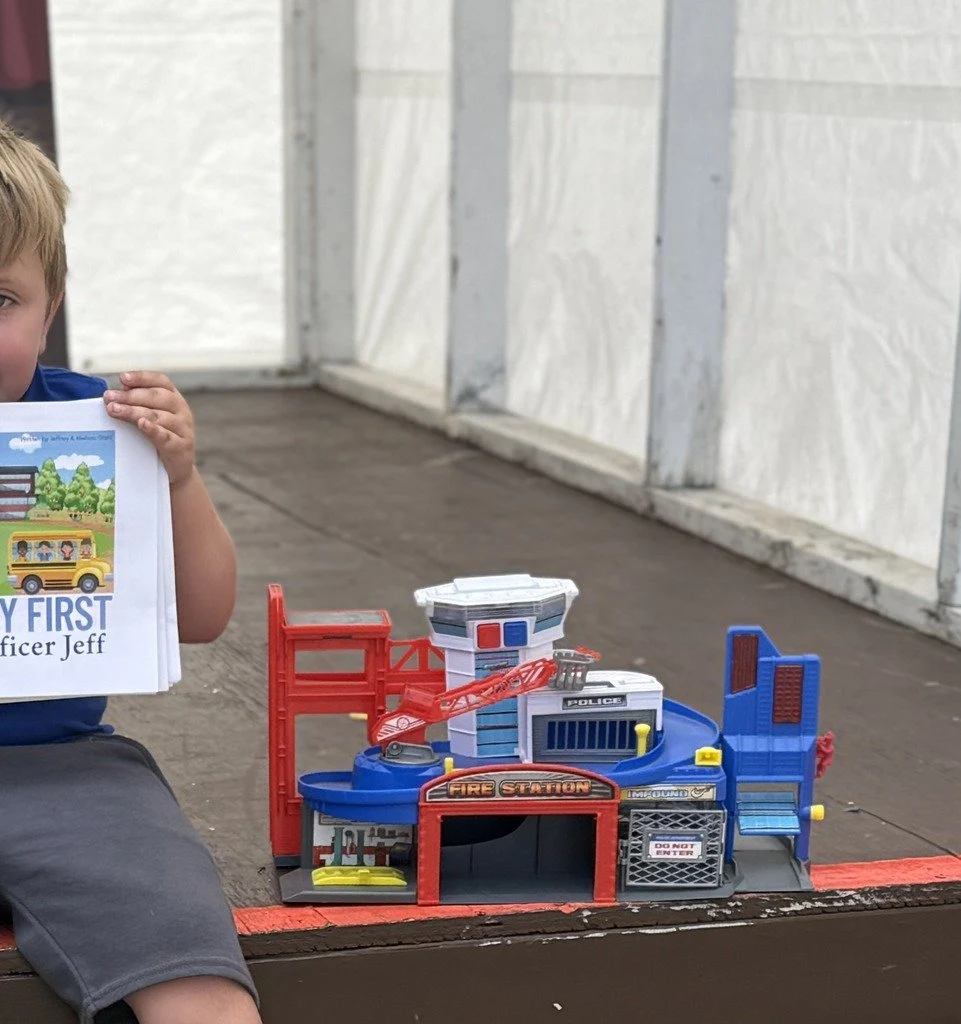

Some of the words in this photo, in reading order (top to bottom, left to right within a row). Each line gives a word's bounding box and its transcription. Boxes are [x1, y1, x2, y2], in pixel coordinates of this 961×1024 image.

[27, 595, 113, 632] FIRST
[60, 632, 107, 661] Jeff
[567, 697, 623, 707] POLICE
[448, 782, 494, 797] FIRE
[500, 780, 590, 796] STATION
